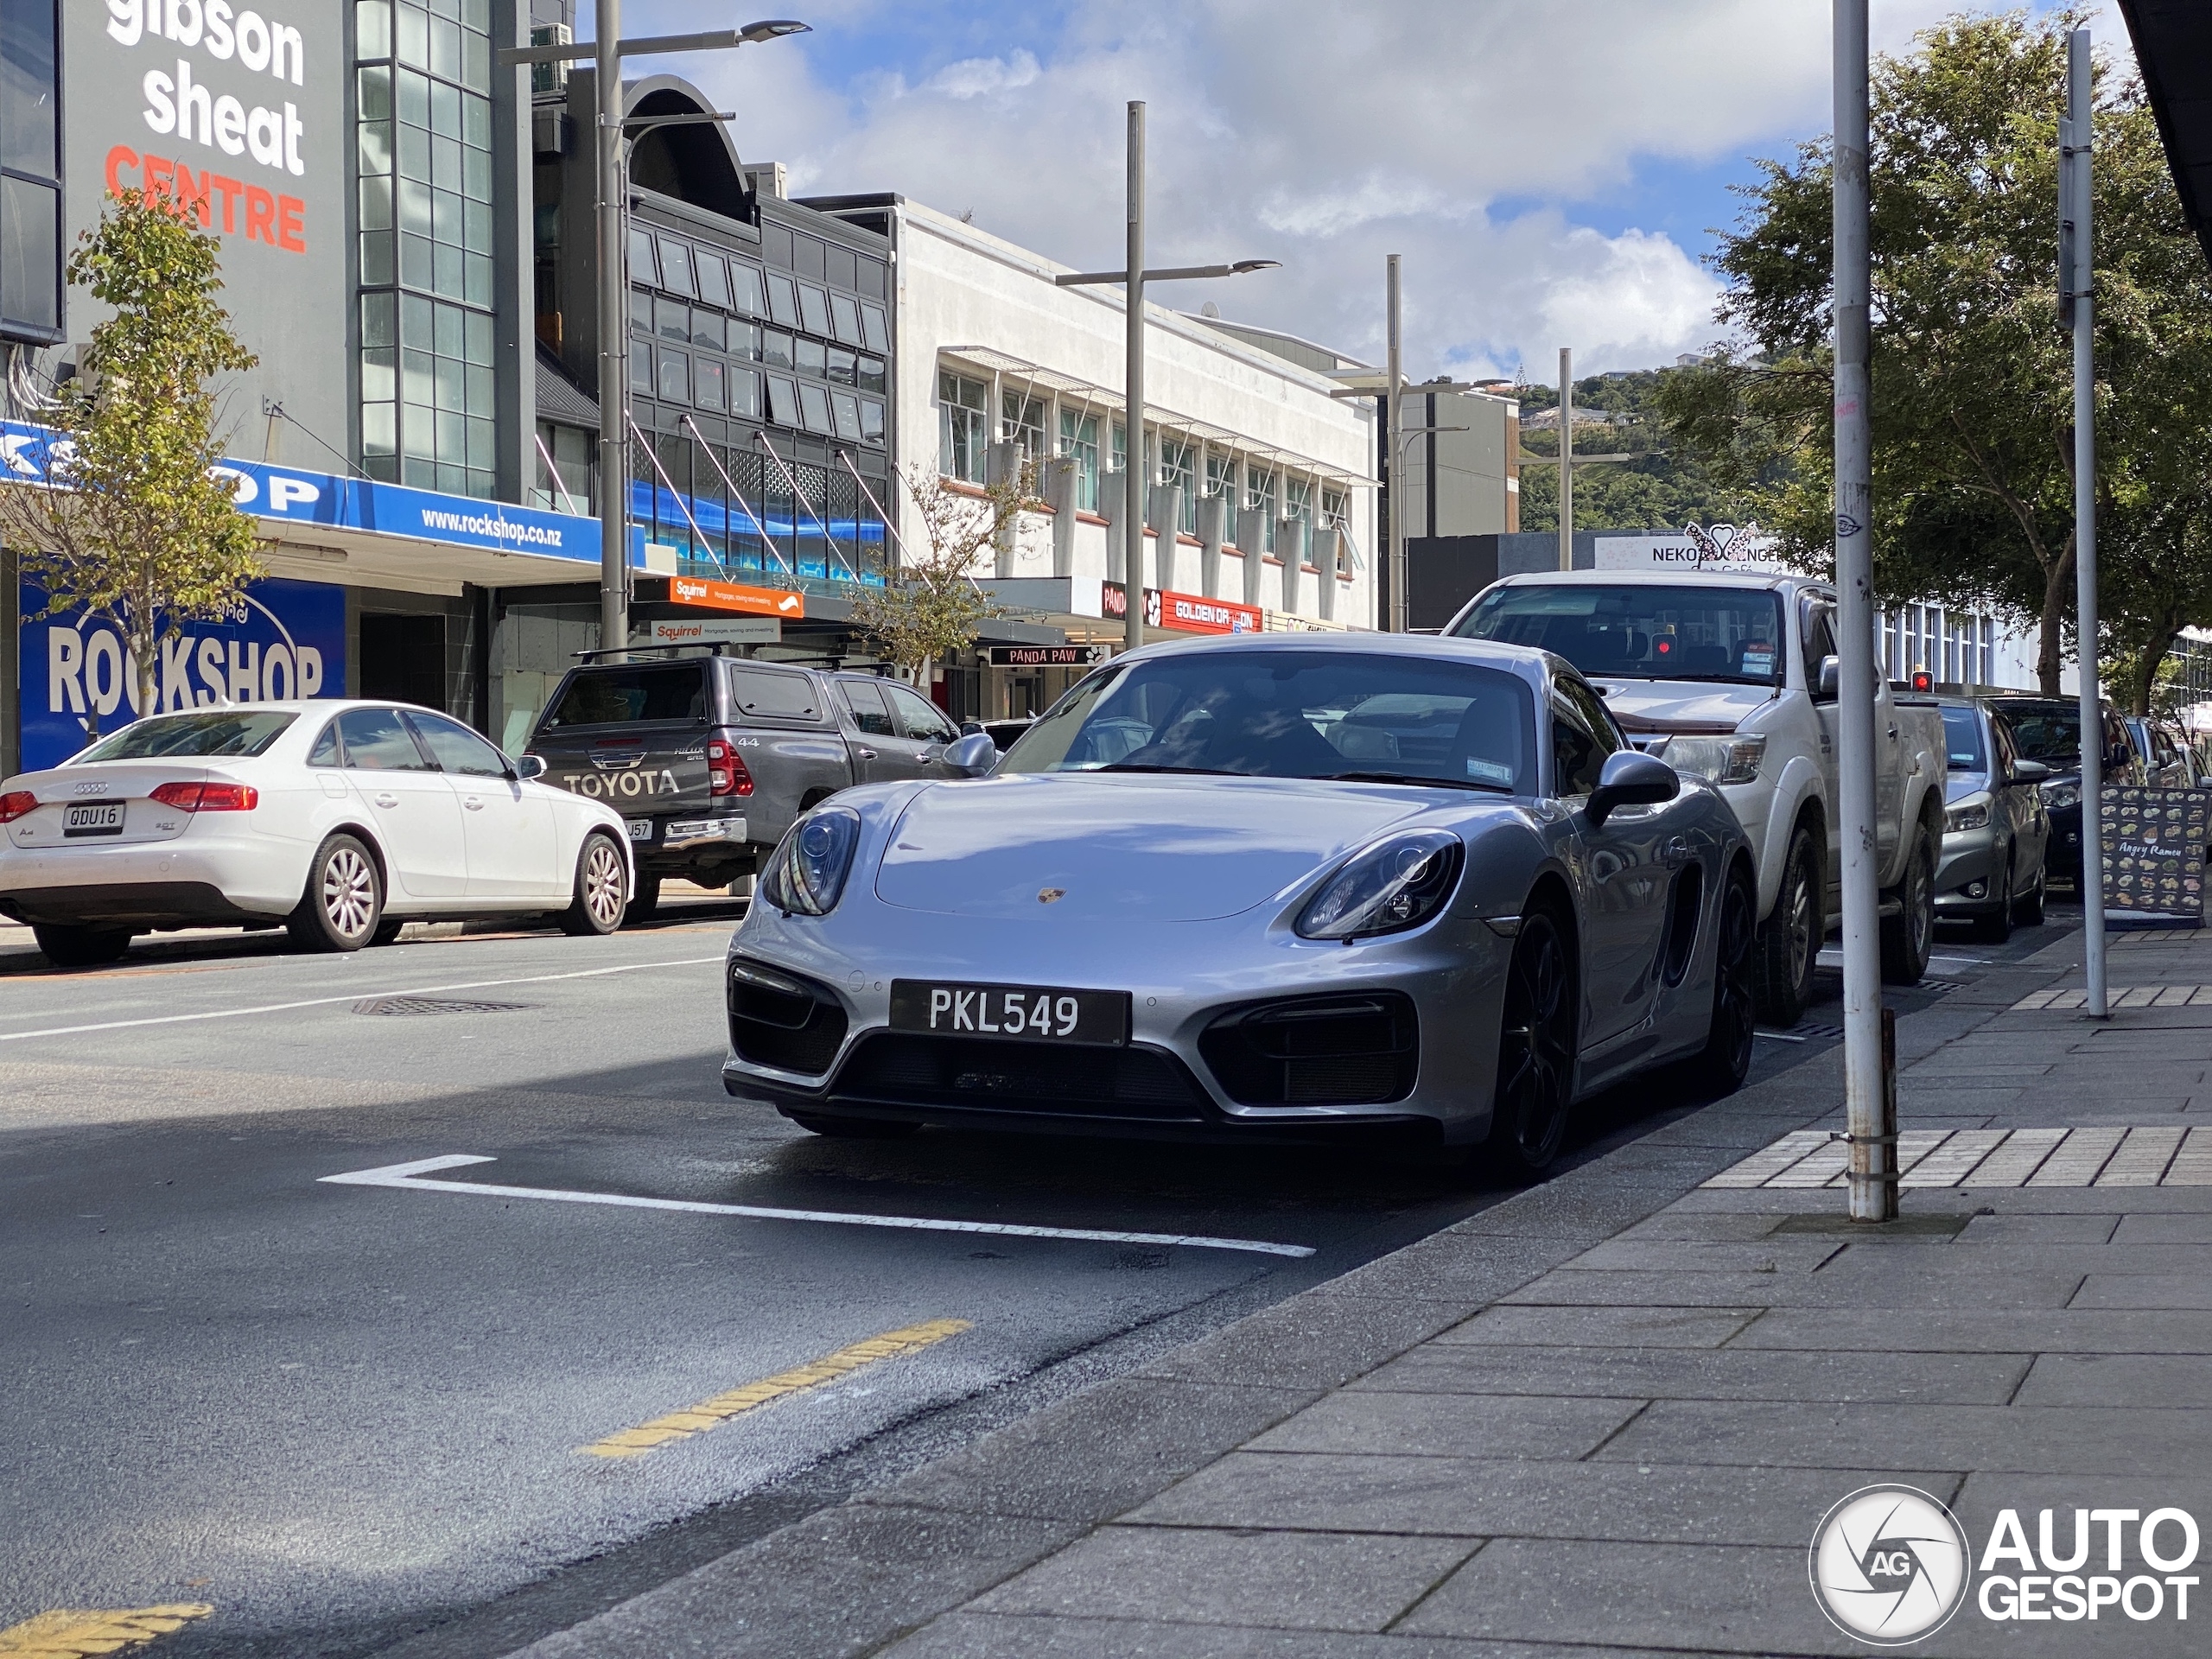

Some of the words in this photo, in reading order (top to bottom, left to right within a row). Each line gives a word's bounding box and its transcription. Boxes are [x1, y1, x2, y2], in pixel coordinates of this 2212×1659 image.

[143, 58, 305, 176] sheat
[105, 143, 306, 255] CENTRE
[422, 509, 563, 547] www.rockshop.co.nz
[1652, 547, 1698, 562] NEKO
[676, 580, 708, 601] Squirrel
[1104, 587, 1127, 615] PAND
[1176, 601, 1215, 623] GOLDEN
[1215, 607, 1253, 629] DRON
[657, 624, 702, 642] Squirrel
[1009, 649, 1047, 664] PANDA
[1052, 649, 1077, 663] PAW
[48, 626, 323, 717] ROCKSHOP
[563, 769, 680, 798] TOYOTA
[70, 807, 117, 827] QDU16
[626, 823, 649, 837] J57
[2119, 842, 2148, 858] Angry
[2150, 845, 2182, 857] Ramen
[929, 988, 1078, 1037] PKL549
